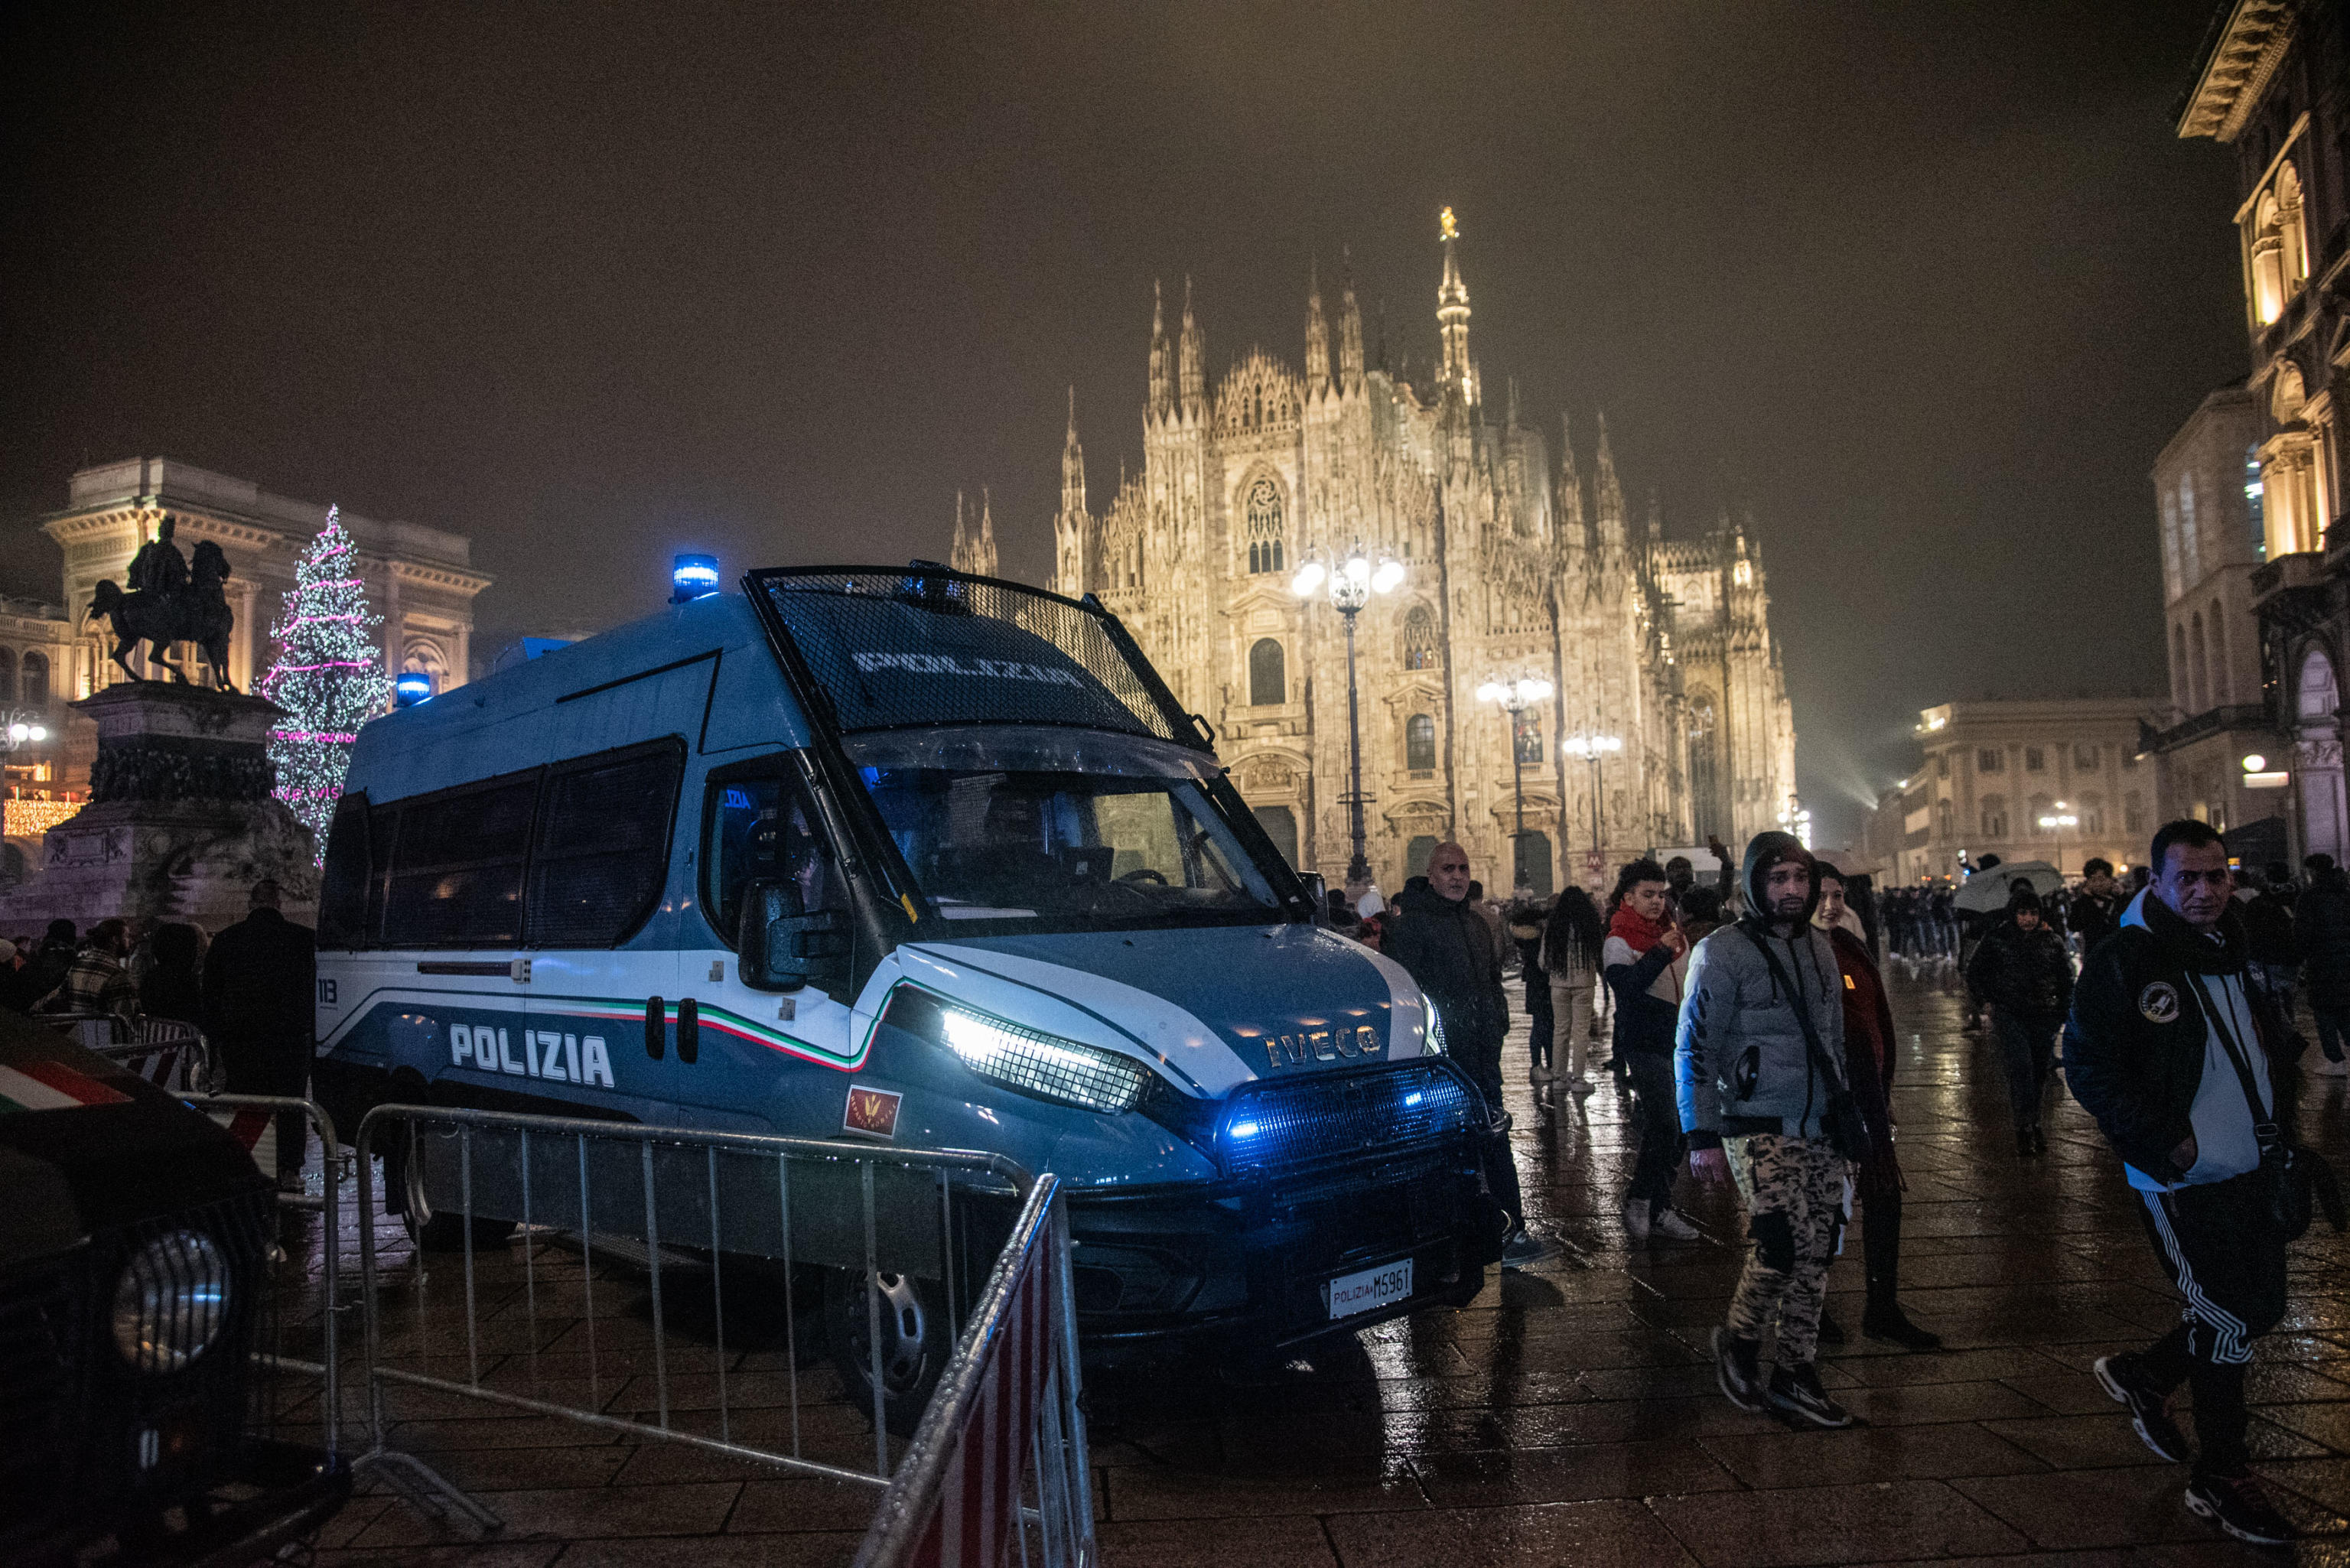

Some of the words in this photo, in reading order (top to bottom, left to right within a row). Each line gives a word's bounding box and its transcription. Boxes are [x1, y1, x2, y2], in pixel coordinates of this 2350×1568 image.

[1588, 856, 1601, 866] M
[317, 978, 337, 1003] 113
[450, 1023, 615, 1088] POLIZIA
[1263, 1026, 1380, 1068] IVECO
[1333, 1284, 1370, 1305] POLIZIA
[1373, 1267, 1408, 1300] M5961
